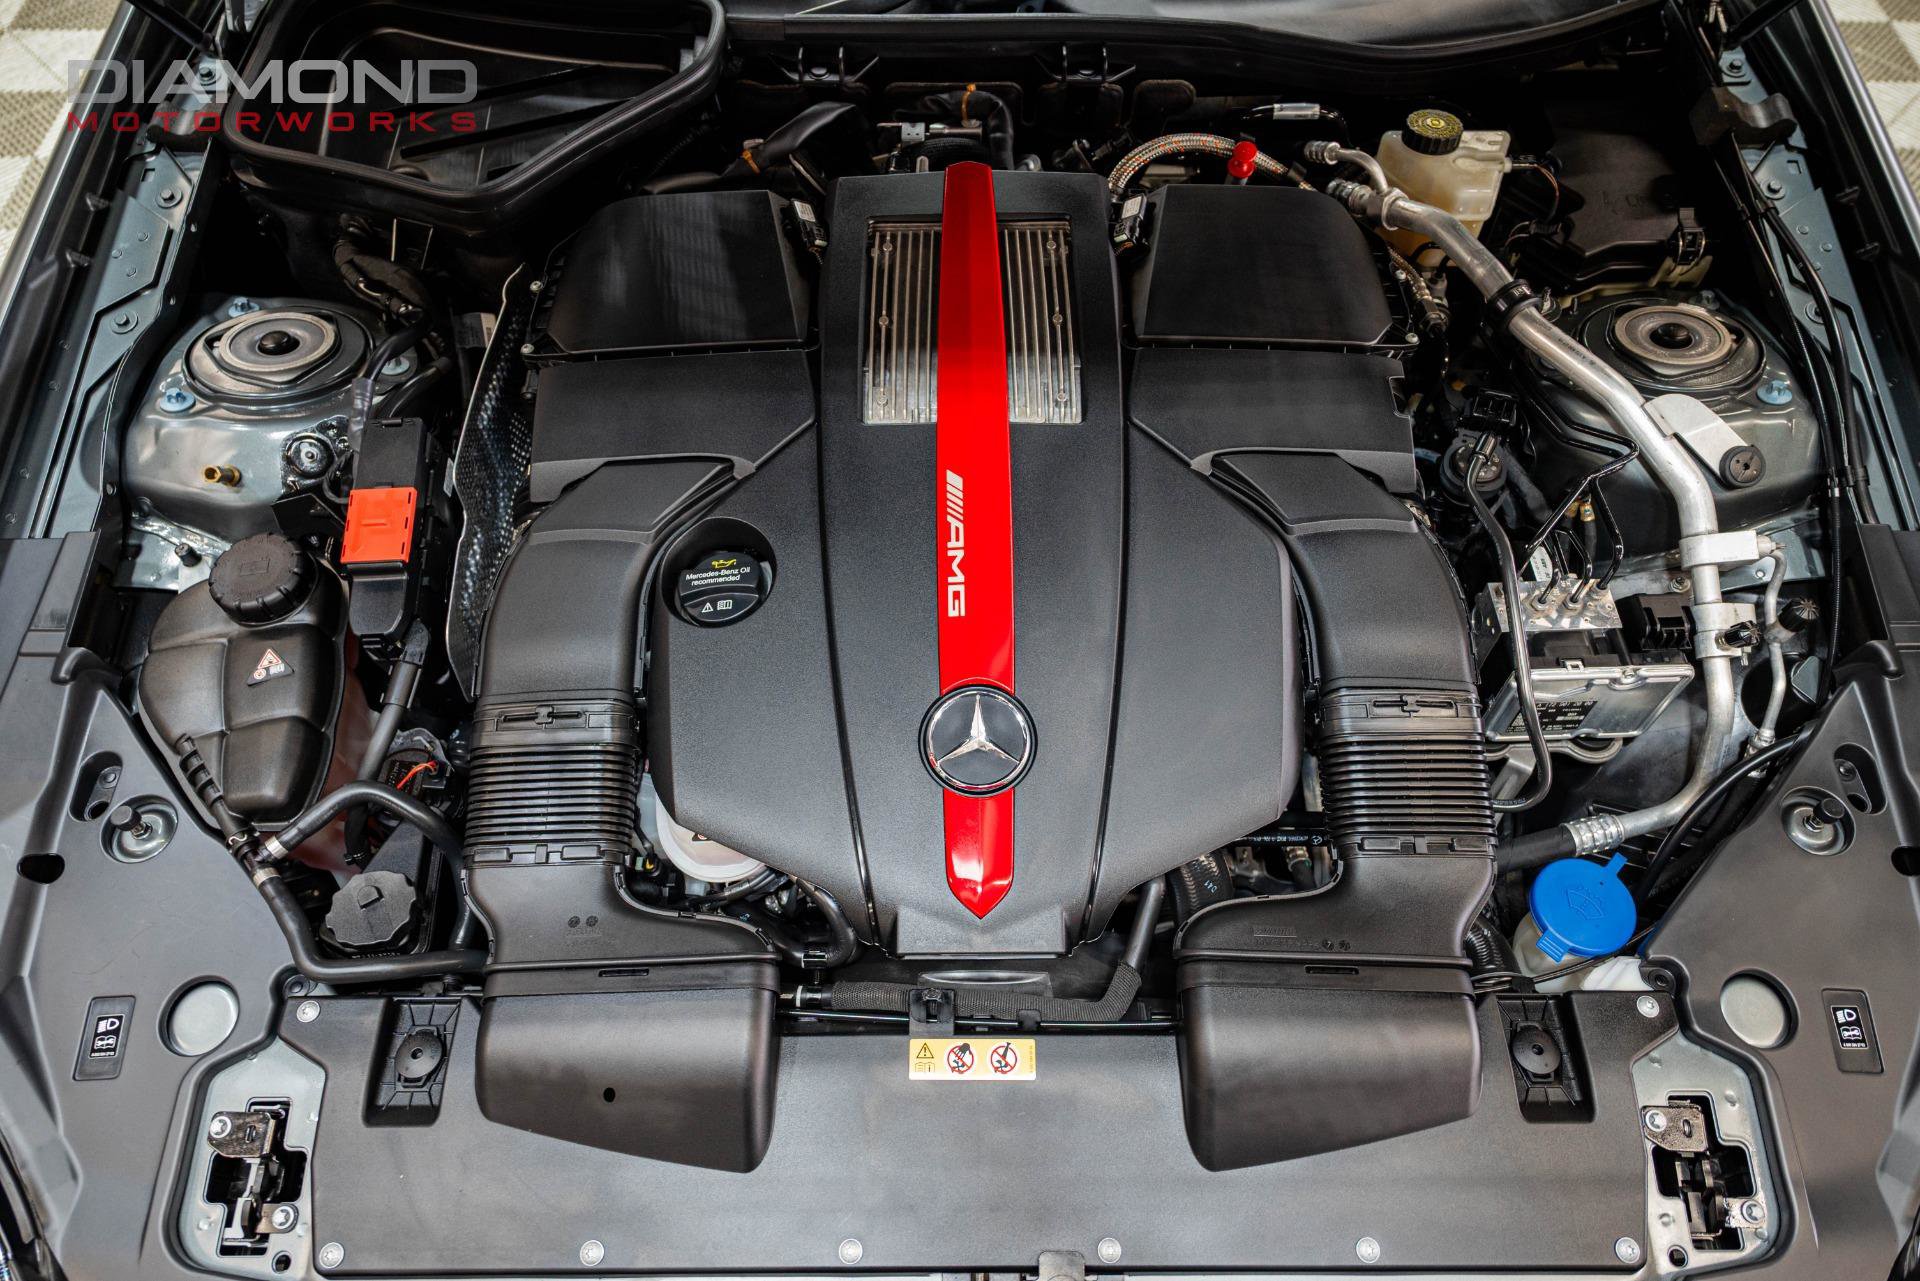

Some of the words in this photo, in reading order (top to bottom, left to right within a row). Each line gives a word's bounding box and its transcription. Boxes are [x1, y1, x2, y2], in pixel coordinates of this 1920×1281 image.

[685, 568, 739, 580] Mercedes-Benz
[740, 566, 750, 574] Oil
[946, 514, 966, 618] AMG
[691, 574, 740, 586] recommended
